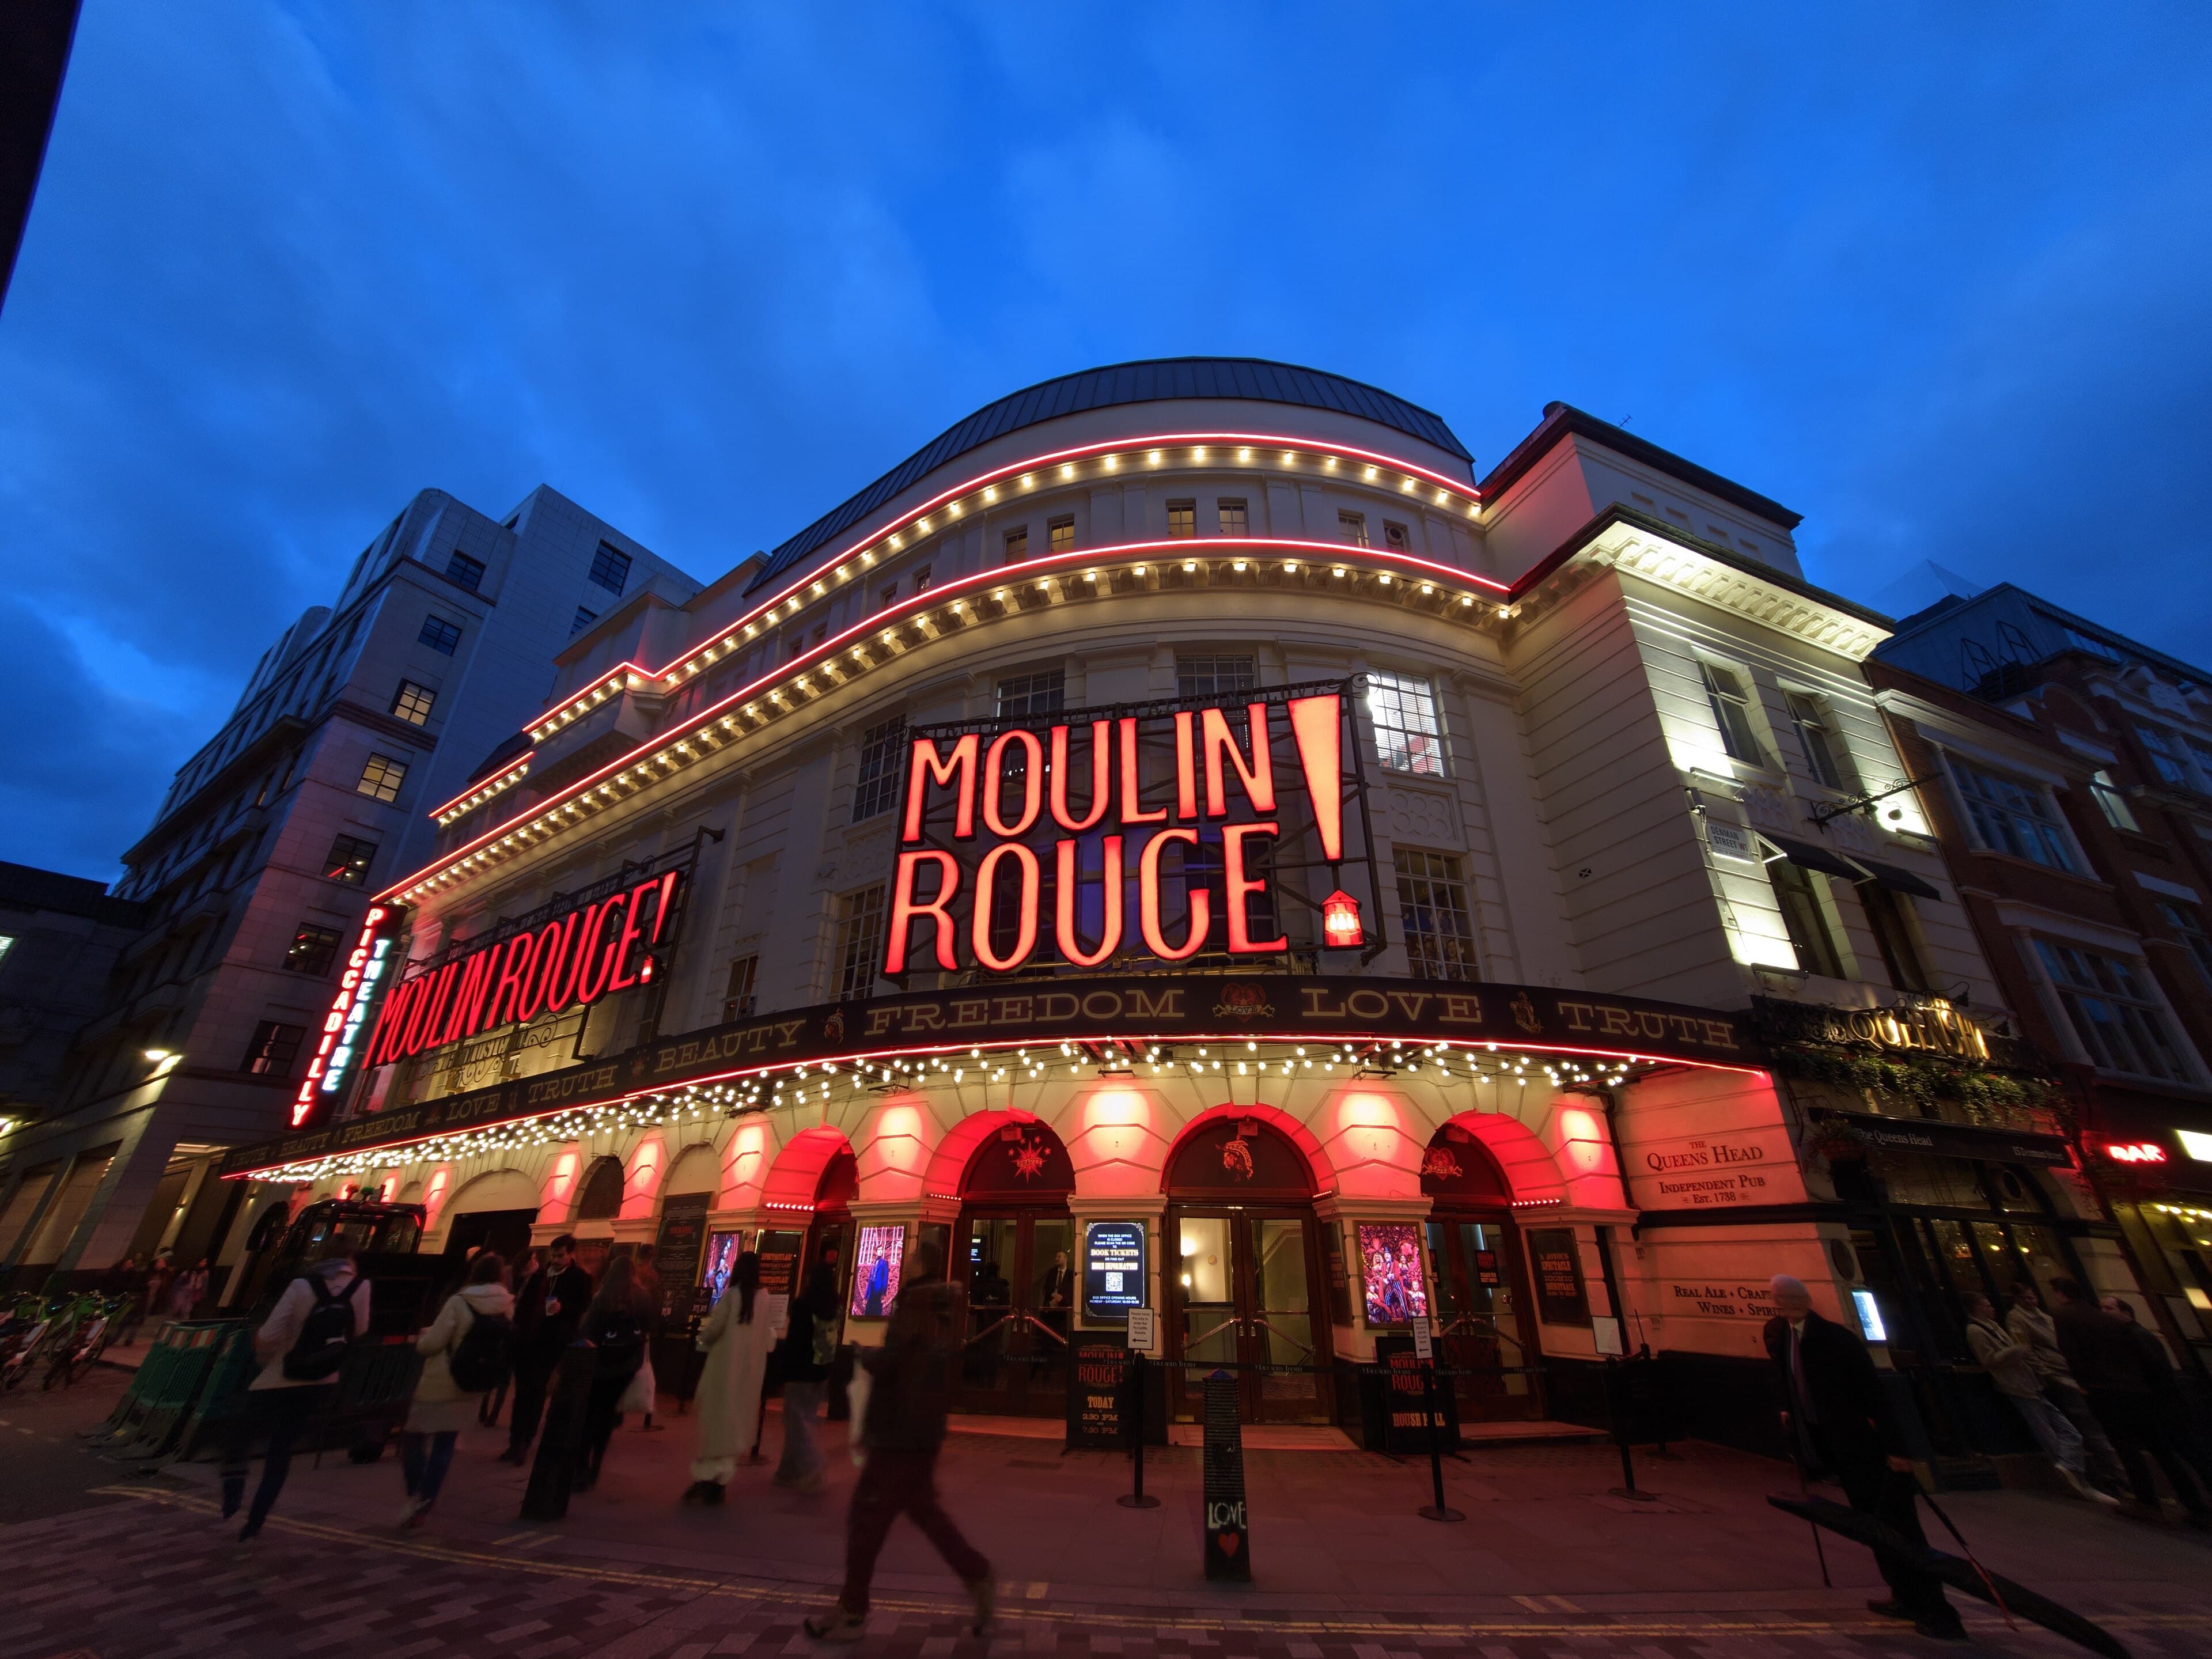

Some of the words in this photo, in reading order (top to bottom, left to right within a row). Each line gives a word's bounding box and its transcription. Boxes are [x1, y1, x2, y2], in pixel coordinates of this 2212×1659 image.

[903, 702, 1276, 841] MOULIN
[1710, 826, 1739, 840] DENMAN
[1714, 836, 1737, 849] STREET
[321, 938, 391, 1091] THEATRE
[362, 944, 501, 1070] MOULIN
[1230, 1005, 1257, 1013] LOVE
[291, 907, 384, 1126] PICCADILLY
[279, 1132, 331, 1156] BEAUTY
[342, 1111, 422, 1143] FREEDOM
[445, 1093, 501, 1122] LOVE
[528, 1065, 619, 1104] TRUTH
[654, 1019, 806, 1073] BEAUTY
[864, 988, 1185, 1036] FREEDOM
[1301, 988, 1482, 1022] LOVE
[1557, 1002, 1740, 1050] TRUTH
[1689, 1141, 1707, 1149] THE
[1874, 1130, 1909, 1145] Queens
[1908, 1133, 1933, 1146] Head
[1647, 1152, 1709, 1171] QUEENS
[1710, 1145, 1763, 1164] HEAD
[2108, 1144, 2166, 1162] BAR
[1658, 1179, 1736, 1194] INDEPENDENT
[1737, 1175, 1766, 1188] PUB
[1673, 1286, 1702, 1297] REAL
[1705, 1286, 1727, 1298] ALE
[1697, 1302, 1735, 1315] WINES
[1088, 1396, 1115, 1408] TODAY
[1392, 1412, 1422, 1427] HOUSE
[1422, 1412, 1446, 1427] FLL
[1208, 1501, 1247, 1529] LOVE
